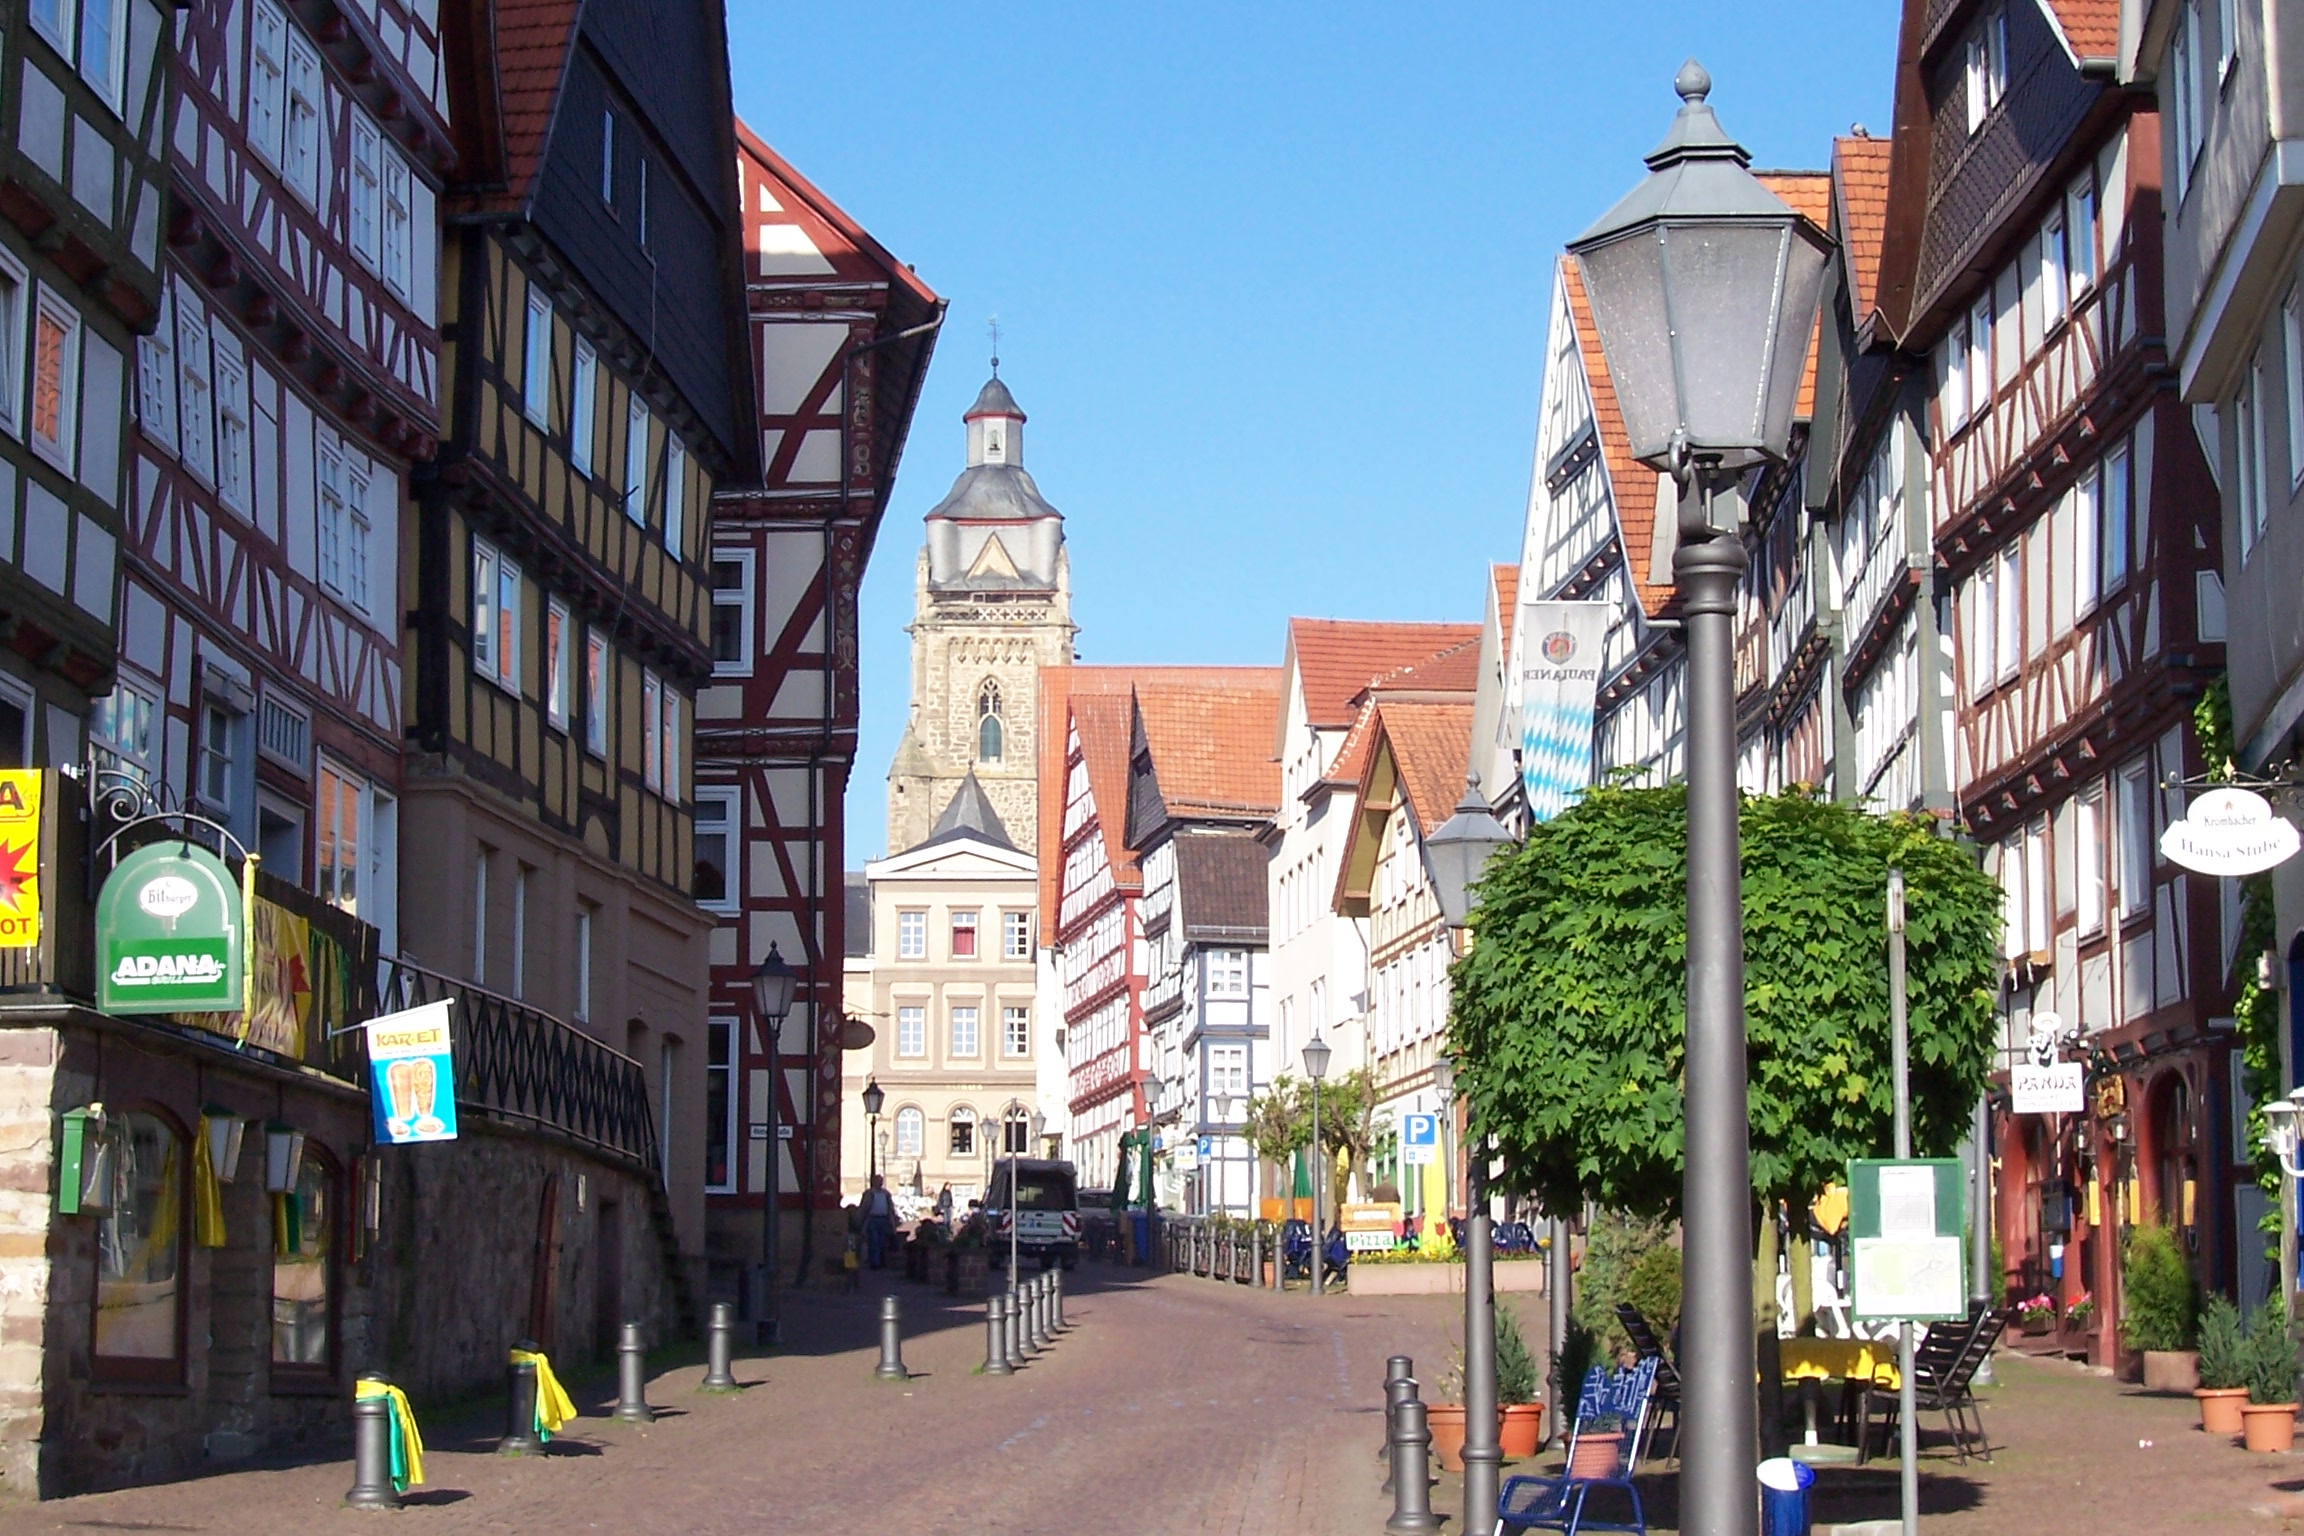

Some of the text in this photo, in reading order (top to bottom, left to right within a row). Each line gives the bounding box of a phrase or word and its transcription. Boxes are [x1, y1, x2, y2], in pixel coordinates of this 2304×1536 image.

[2204, 814, 2257, 827] Krombacher
[2236, 839, 2281, 857] Stube
[117, 953, 218, 978] ADANA
[2017, 1075, 2077, 1091] PANDA
[1410, 1116, 1430, 1143] P
[1200, 1139, 1208, 1154] P
